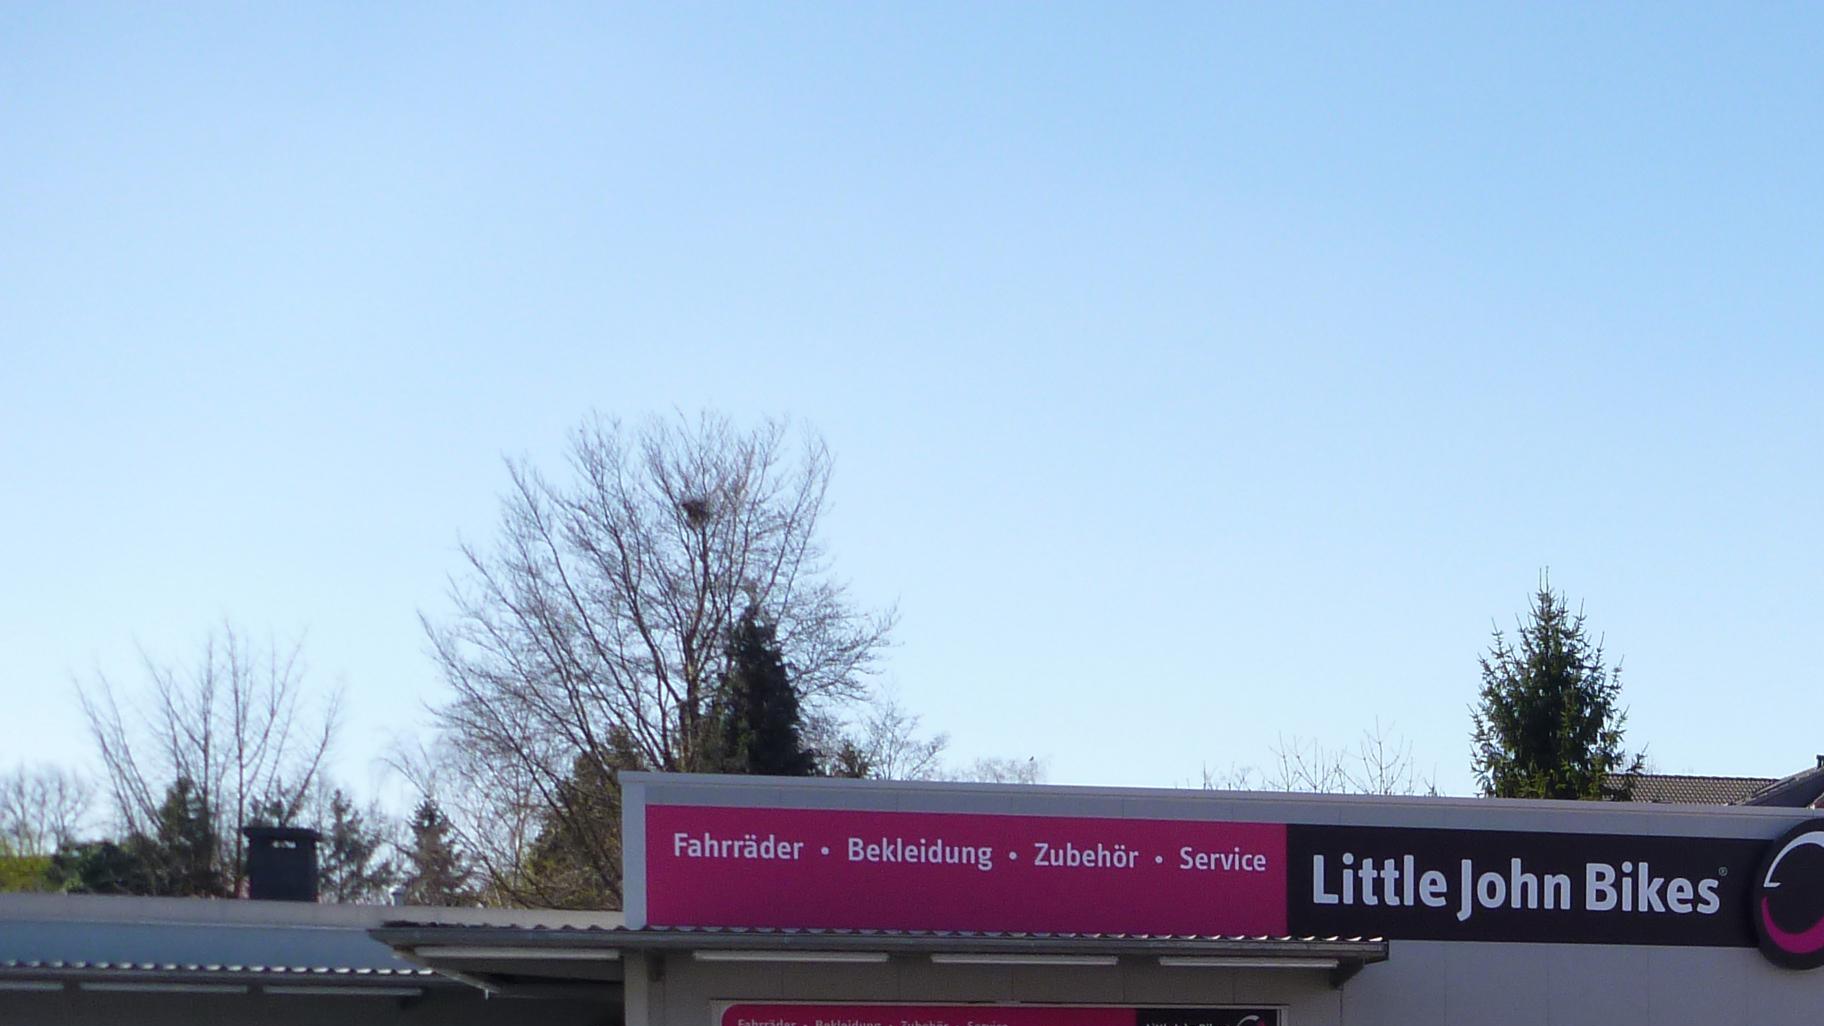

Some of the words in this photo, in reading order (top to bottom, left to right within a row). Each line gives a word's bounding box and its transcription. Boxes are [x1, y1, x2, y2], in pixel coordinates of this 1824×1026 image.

[673, 832, 804, 860] Fahrräder
[847, 837, 993, 871] Bekleidung
[1033, 842, 1140, 869] Zubehör
[1178, 846, 1267, 872] Service
[1312, 852, 1448, 908] Little
[1456, 857, 1571, 922] John
[1585, 860, 1721, 914] Bikes
